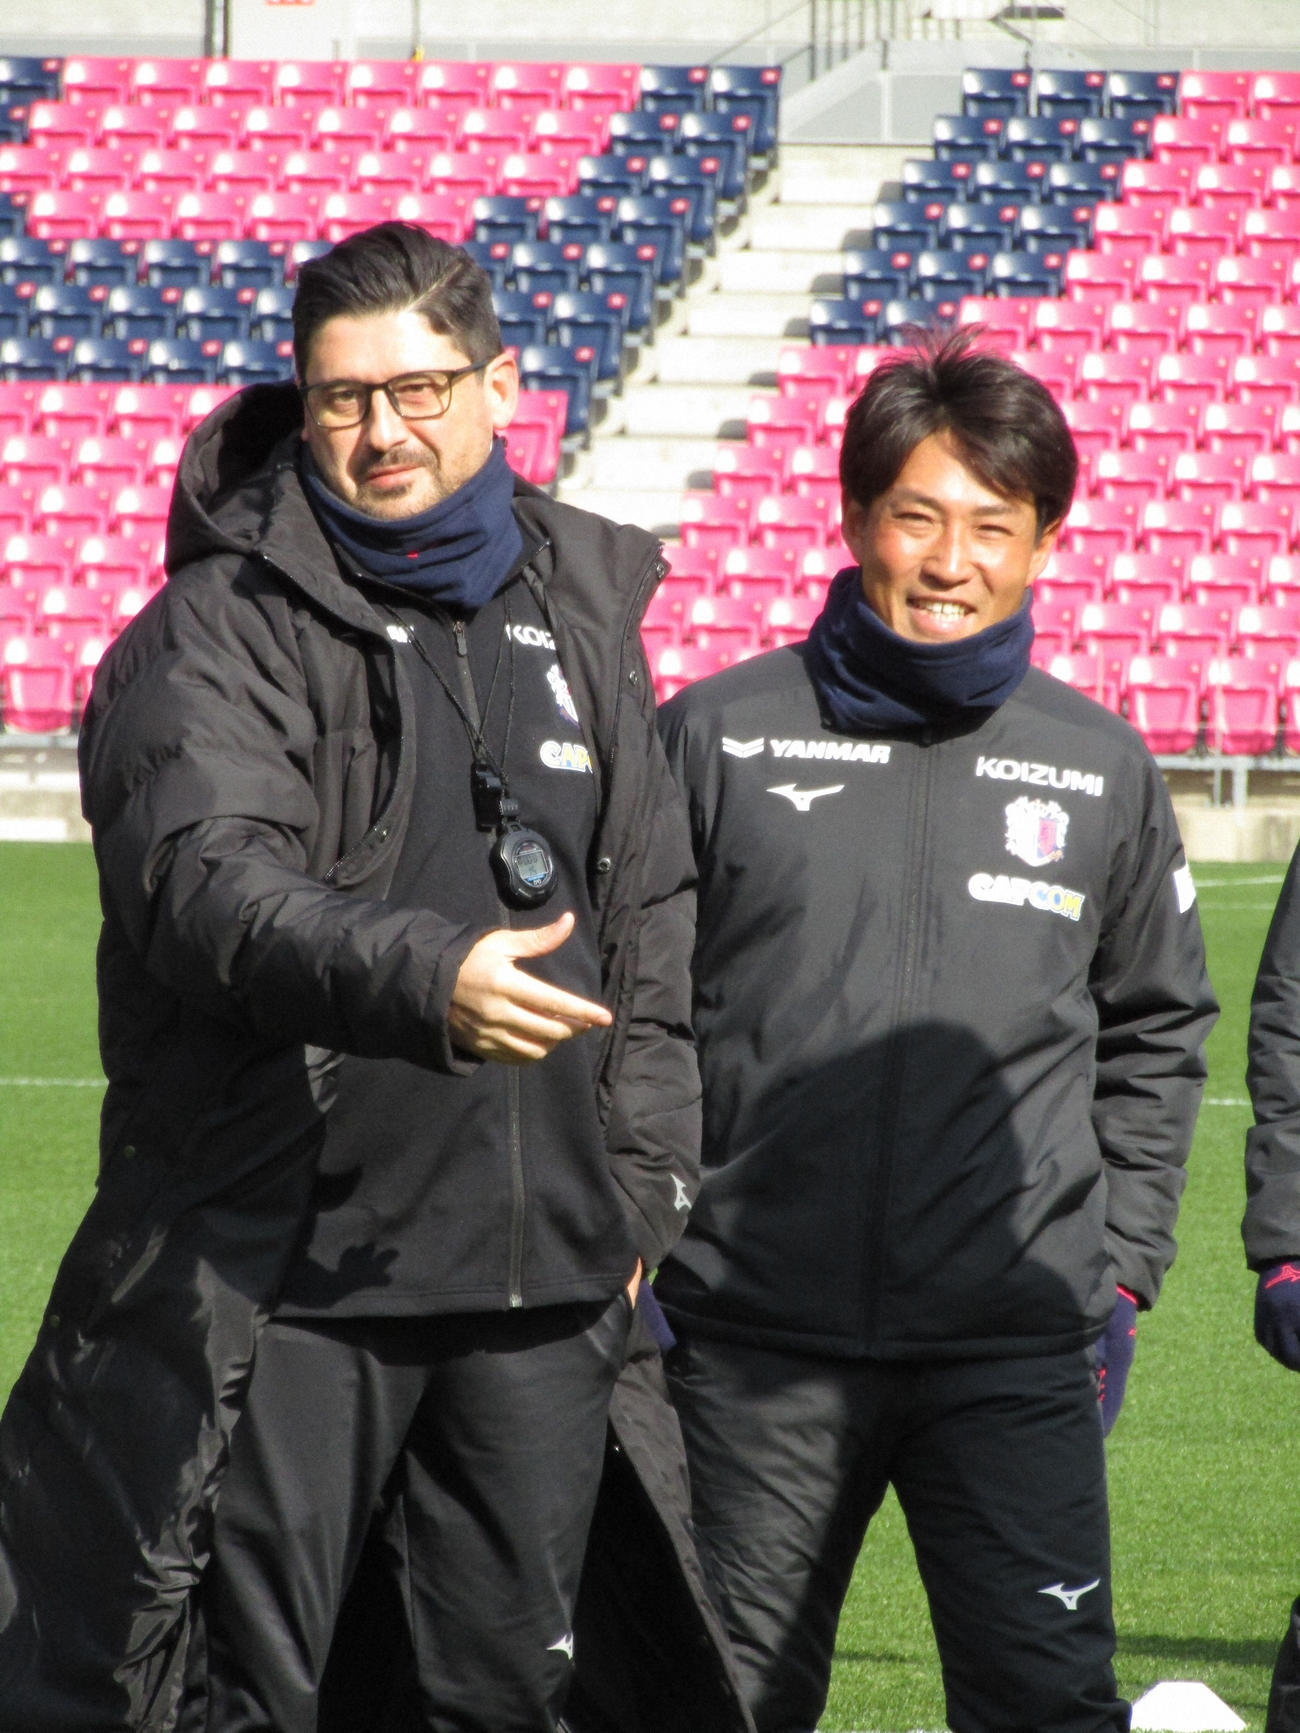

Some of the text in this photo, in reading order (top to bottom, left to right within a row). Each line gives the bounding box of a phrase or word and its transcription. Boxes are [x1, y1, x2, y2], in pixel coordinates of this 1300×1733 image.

[540, 741, 593, 774] CAP
[770, 739, 891, 764] YANMAR
[975, 755, 1104, 797] KOIZUMI
[968, 873, 1086, 922] CAPCOM
